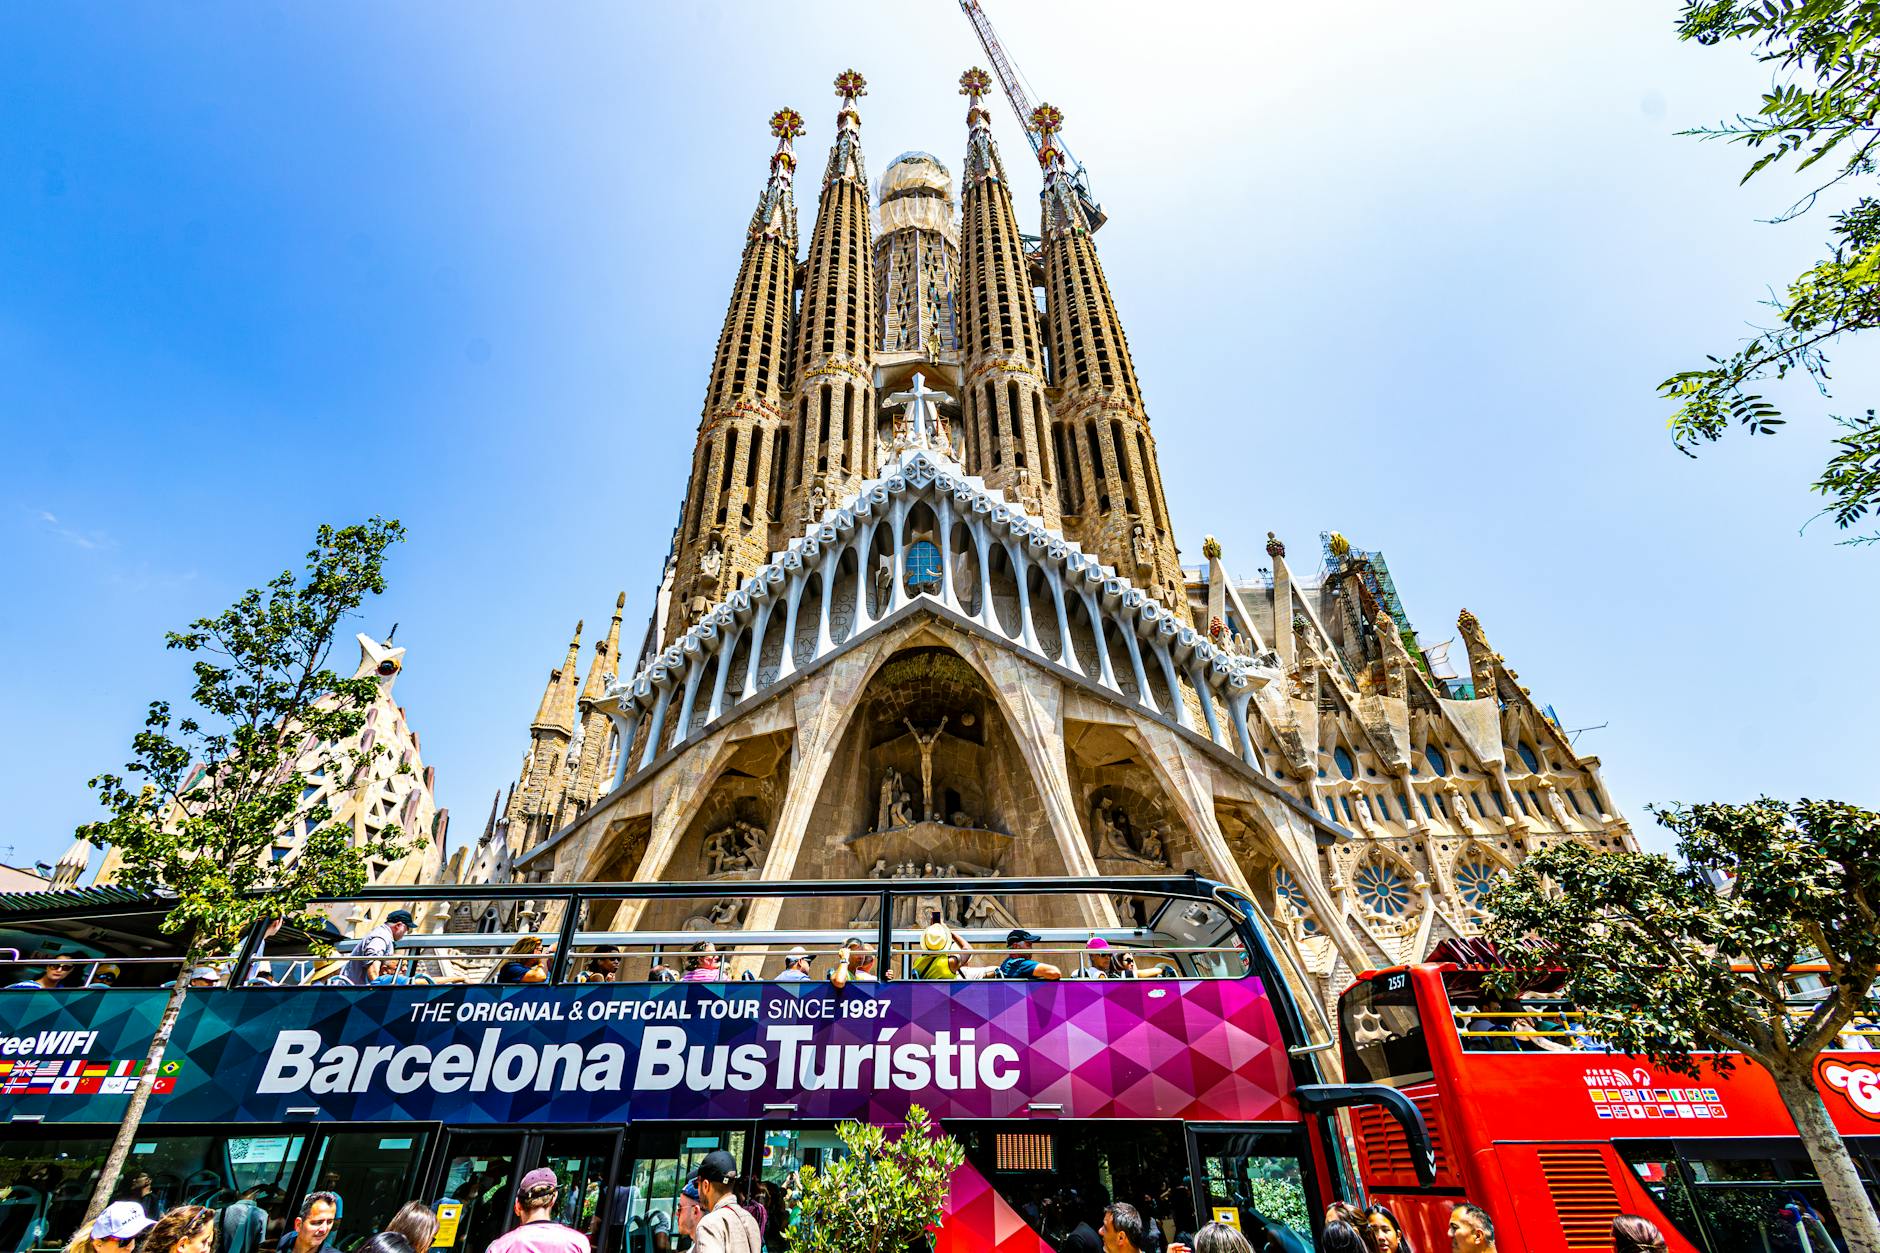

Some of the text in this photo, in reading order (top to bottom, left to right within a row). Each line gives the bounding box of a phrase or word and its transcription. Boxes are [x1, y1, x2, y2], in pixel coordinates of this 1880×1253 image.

[733, 486, 886, 608] NAZARENUS
[975, 495, 1028, 534] REX
[1388, 974, 1405, 991] 2557
[410, 1002, 454, 1022] THE
[568, 1001, 583, 1021] &
[587, 1000, 692, 1020] OFFICIAL
[697, 999, 759, 1019] TOUR
[767, 998, 835, 1019] SINCE
[839, 999, 891, 1018] 1987
[0, 1030, 99, 1055] reeWIFI
[256, 1027, 625, 1094] Barcelona
